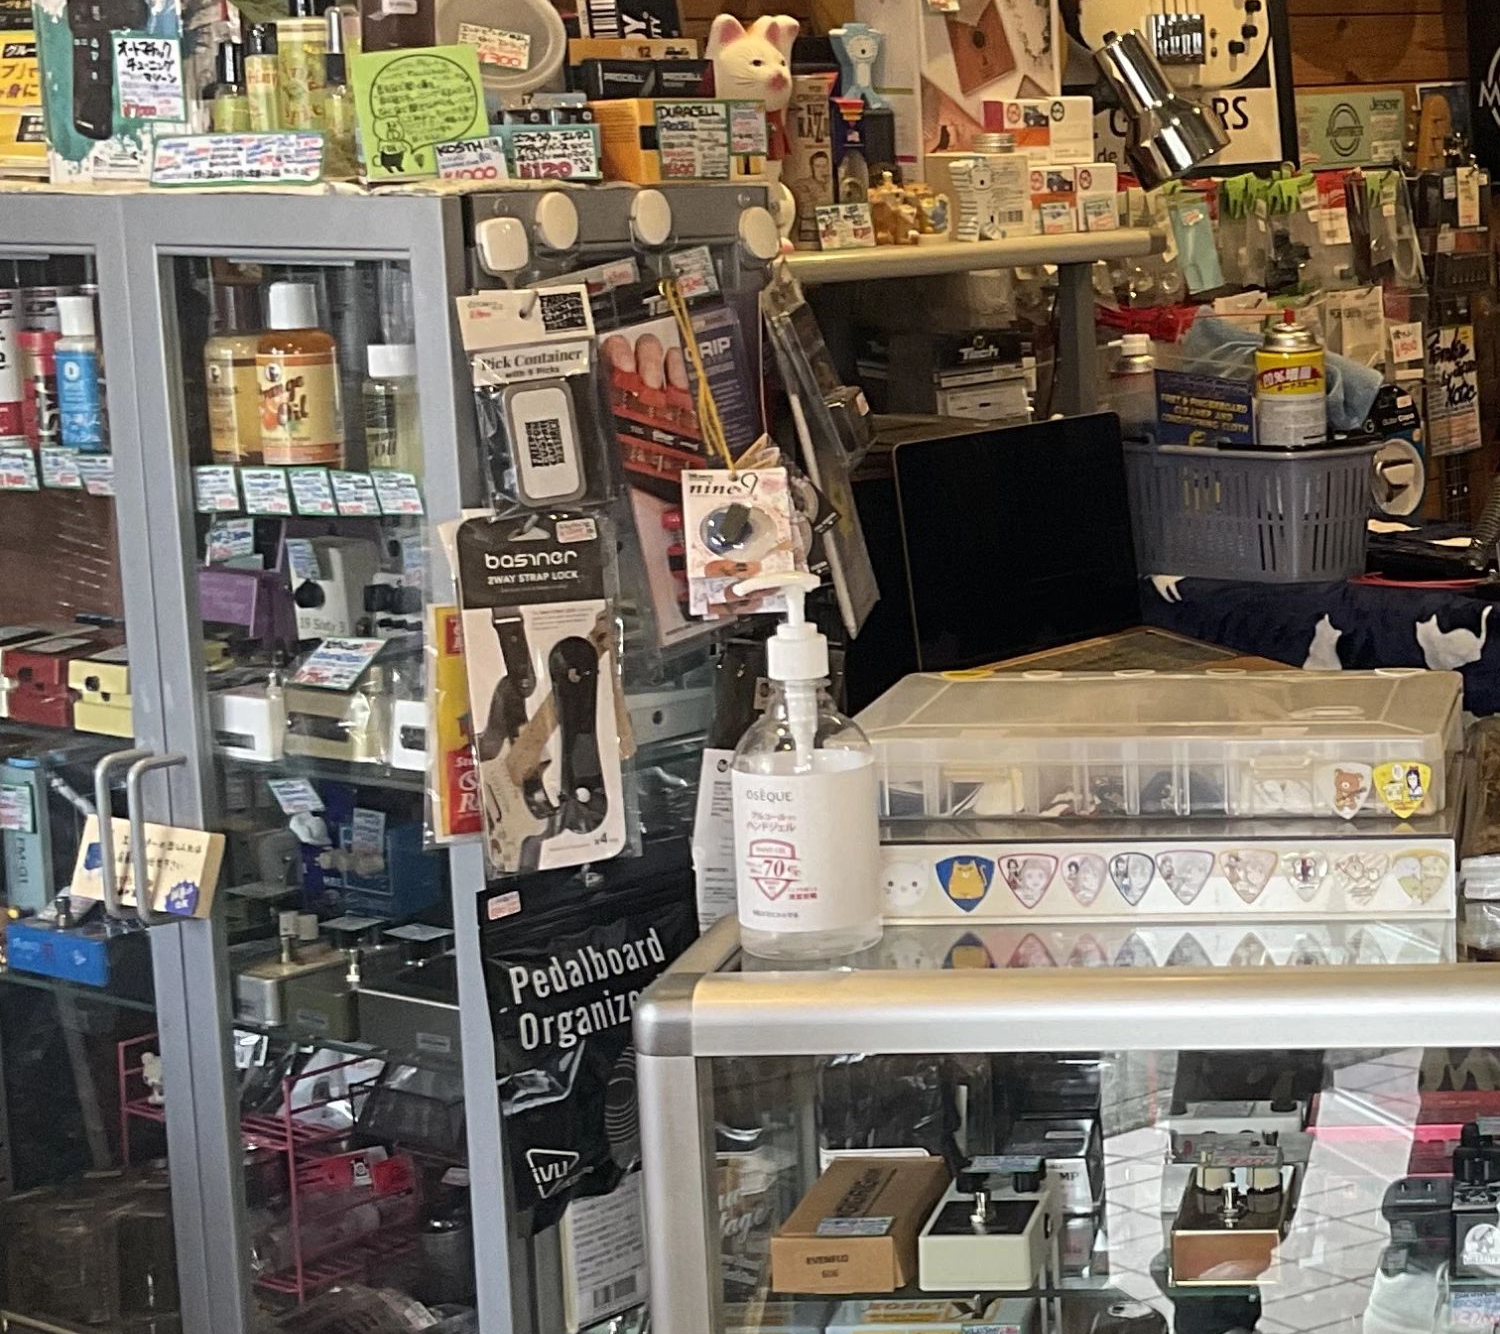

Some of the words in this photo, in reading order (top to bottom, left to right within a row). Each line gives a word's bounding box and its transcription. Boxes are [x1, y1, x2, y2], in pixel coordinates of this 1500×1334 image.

[515, 348, 583, 367] Container
[517, 571, 550, 585] STRAP
[552, 569, 579, 581] LOCK
[763, 859, 785, 878] 70
[508, 927, 666, 1005] Pedalboard
